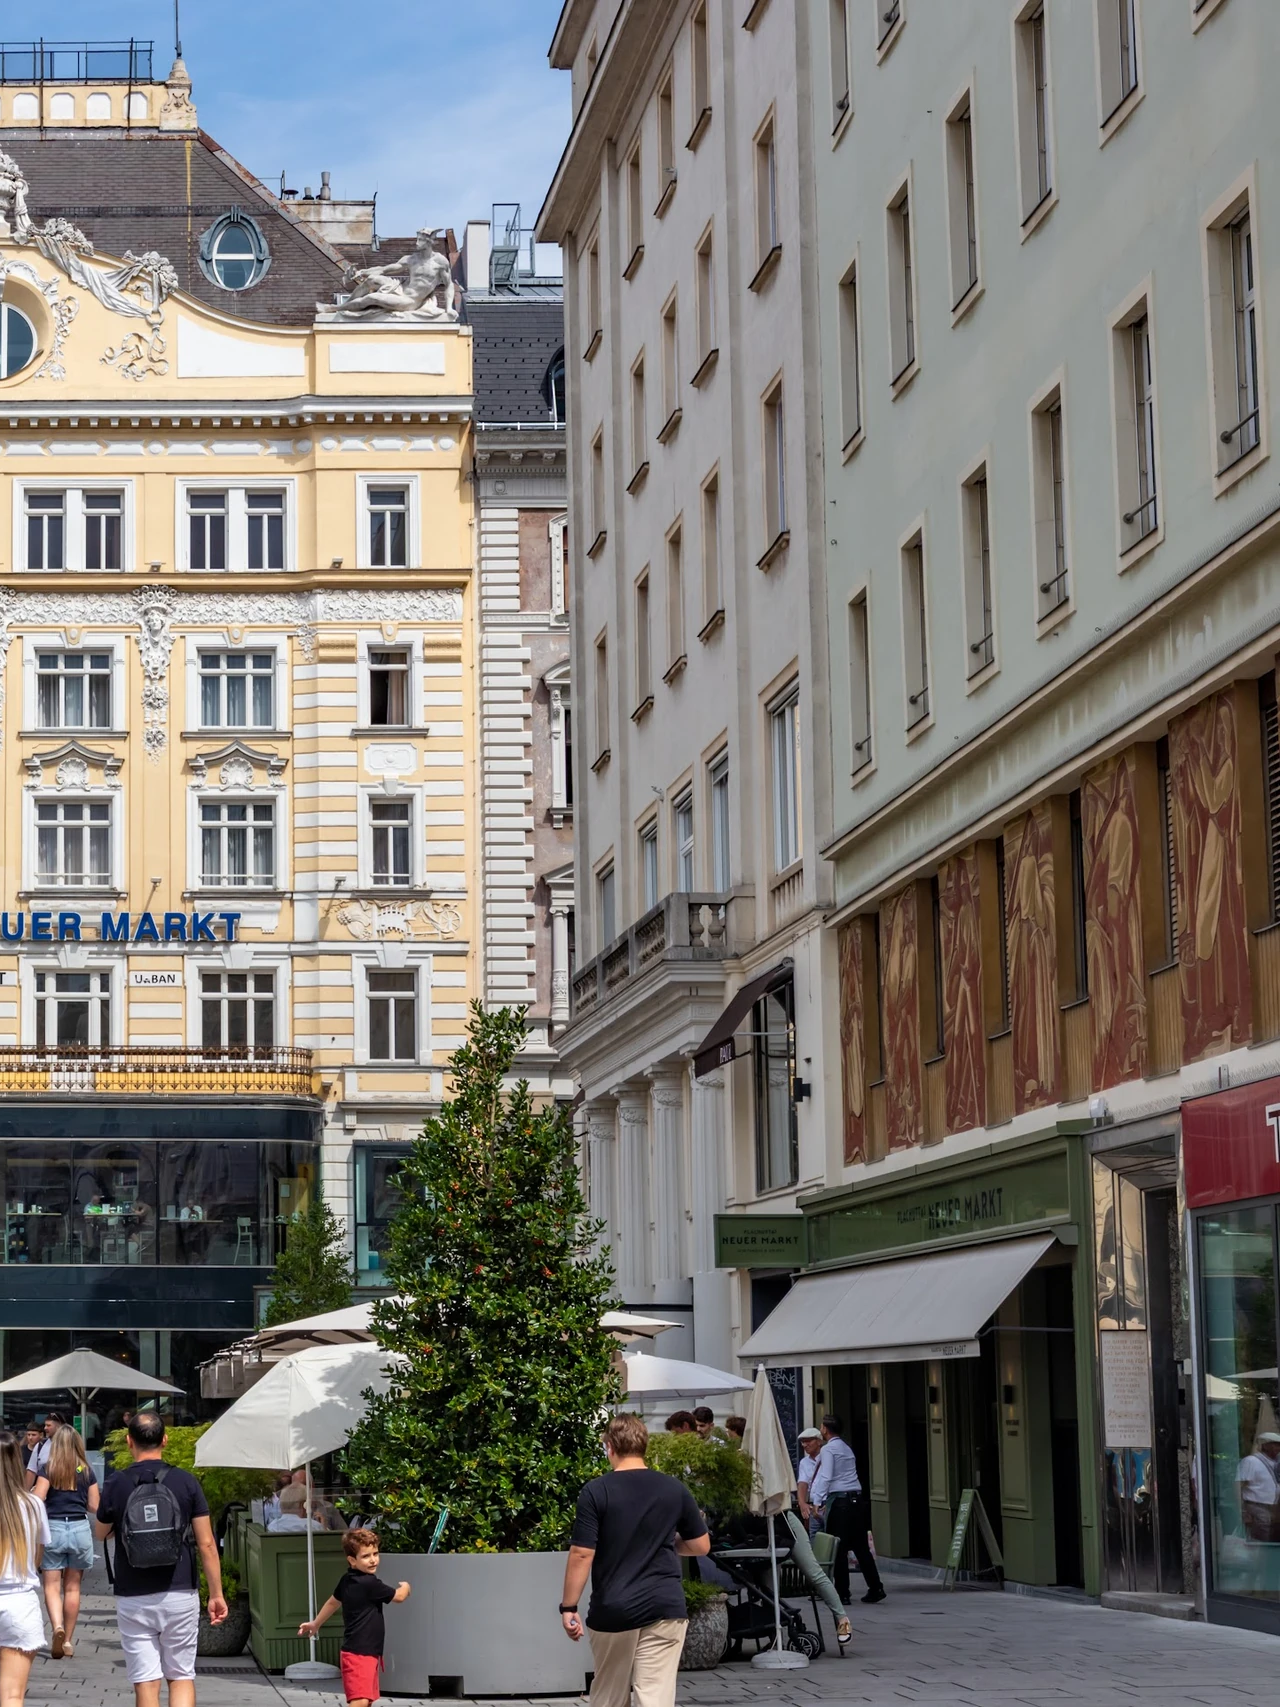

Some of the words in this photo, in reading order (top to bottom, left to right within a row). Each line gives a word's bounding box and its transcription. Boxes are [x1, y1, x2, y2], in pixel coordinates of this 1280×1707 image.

[100, 911, 242, 941] MARKT
[928, 1197, 961, 1230] NEUER
[964, 1187, 1003, 1222] MARKT
[722, 1236, 757, 1245] NEUER
[761, 1236, 799, 1245] MARKT
